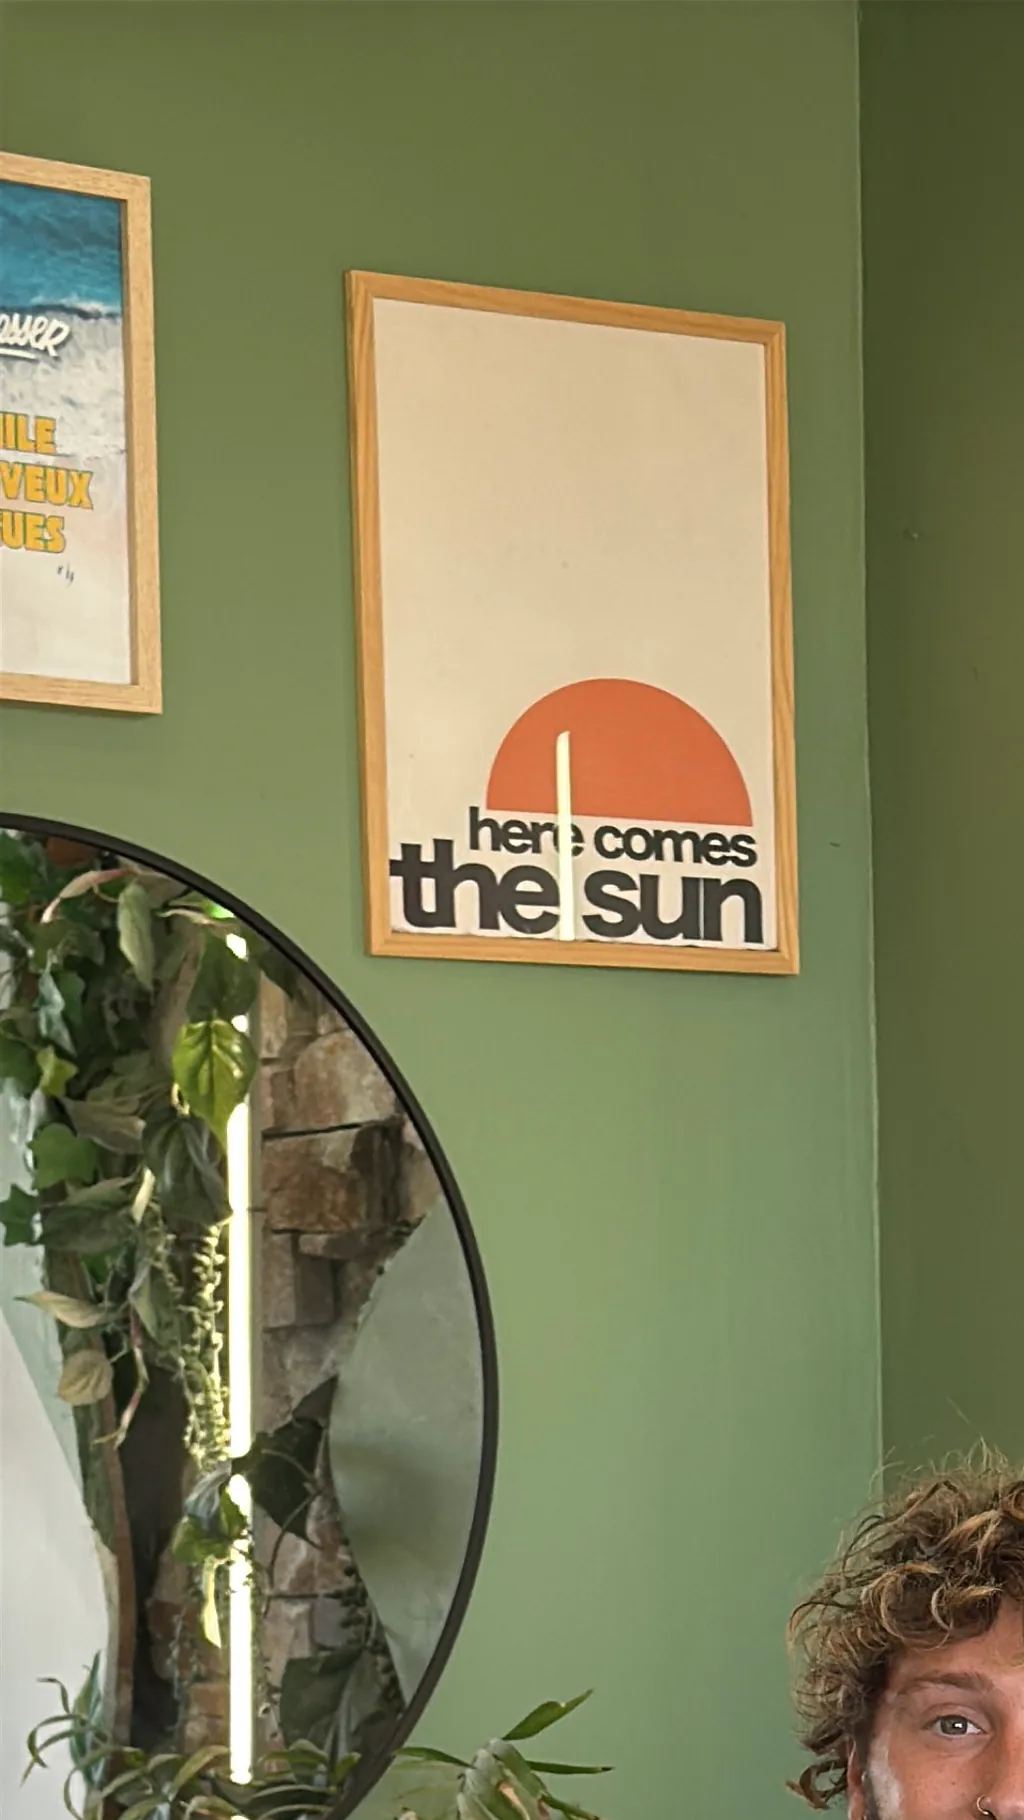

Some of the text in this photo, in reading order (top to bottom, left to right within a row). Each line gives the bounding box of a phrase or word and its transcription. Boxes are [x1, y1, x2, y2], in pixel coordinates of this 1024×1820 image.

[0, 411, 56, 454] ILE
[0, 460, 93, 510] VEUX
[0, 509, 66, 553] UES
[469, 806, 758, 867] here comes
[389, 838, 764, 944] the sun
